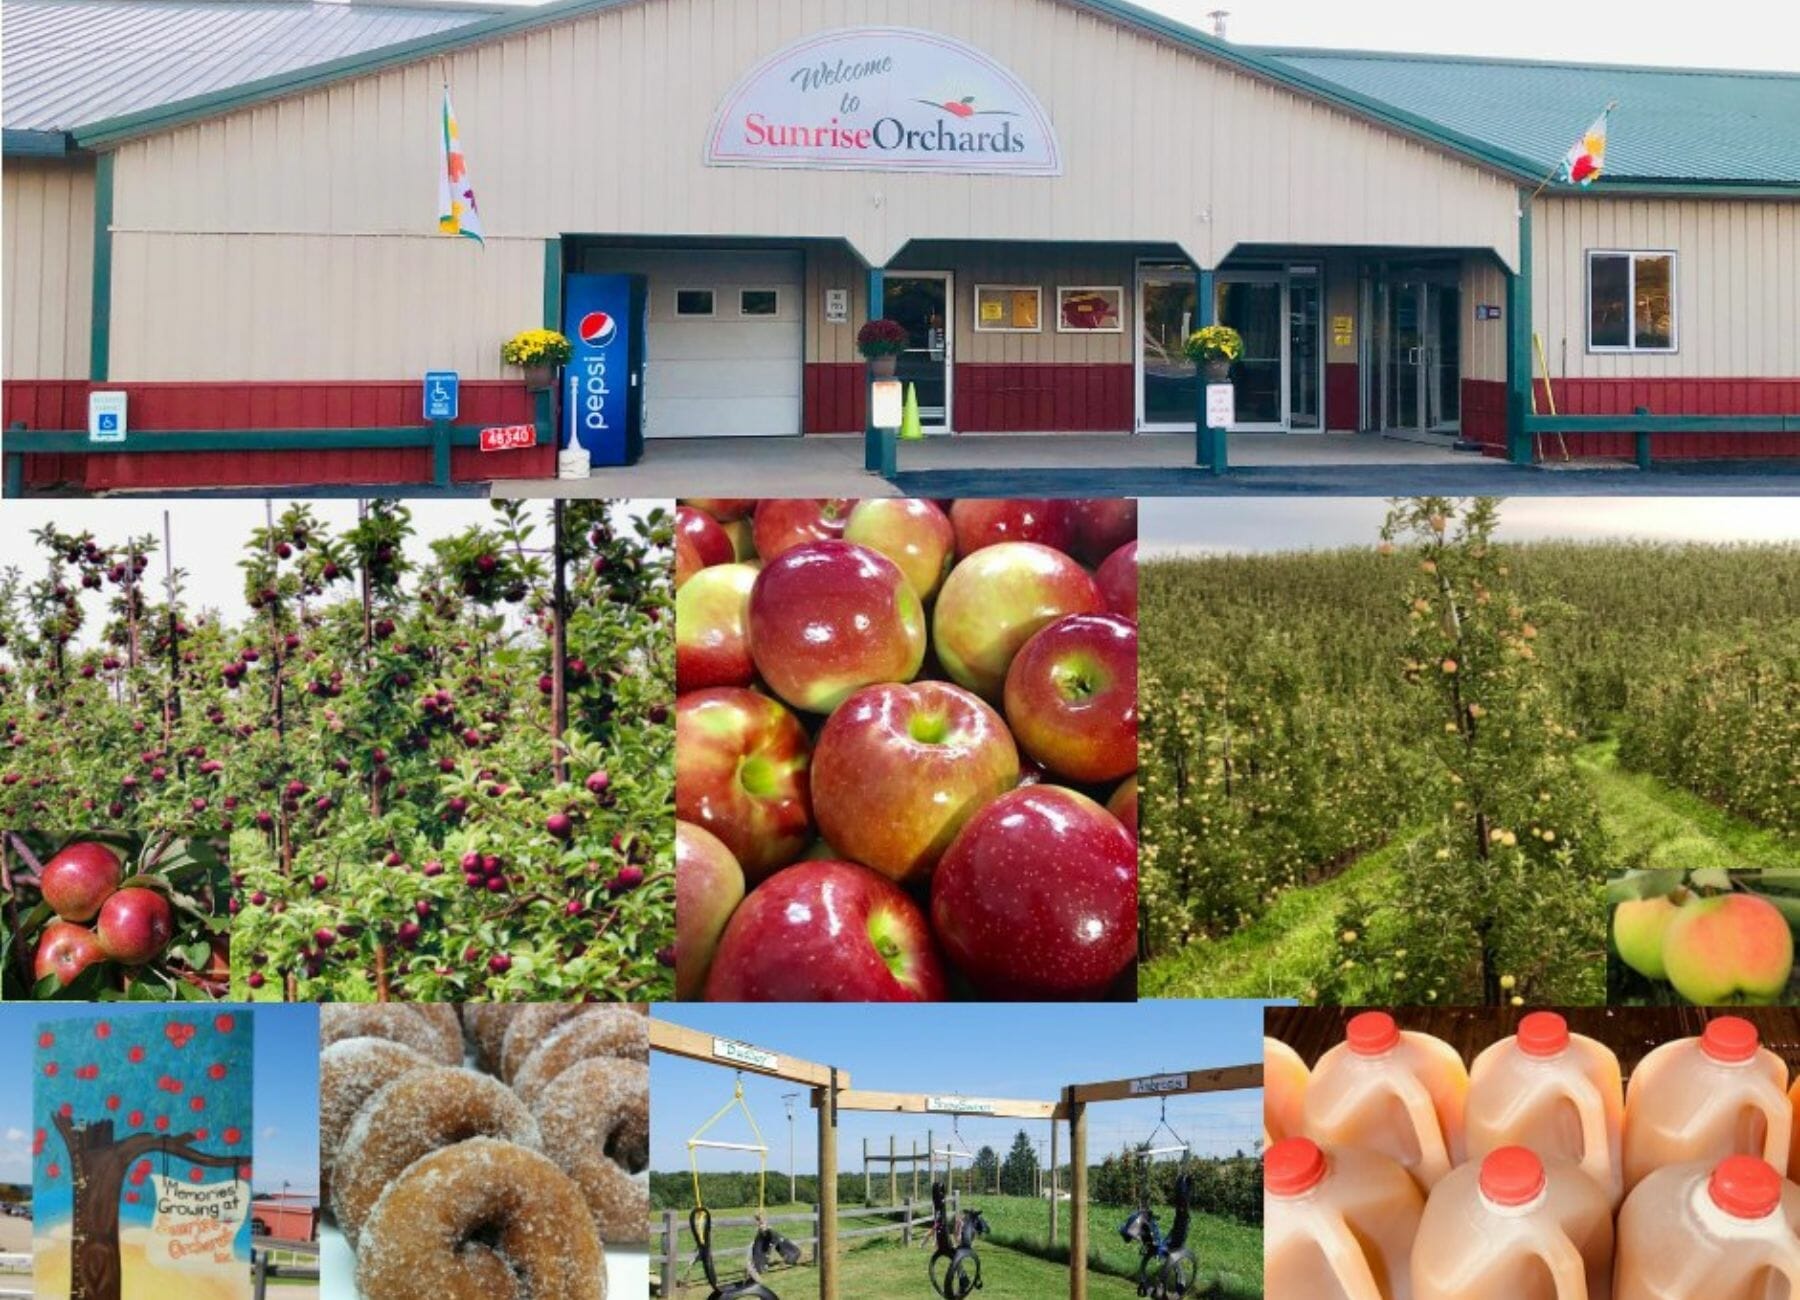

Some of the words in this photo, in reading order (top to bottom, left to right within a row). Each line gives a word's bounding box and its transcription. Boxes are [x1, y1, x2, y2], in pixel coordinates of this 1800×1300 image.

[790, 55, 893, 93] Welcome
[839, 92, 861, 114] to
[165, 1180, 236, 1202] Memories
[158, 1198, 219, 1218] Growing
[223, 1196, 239, 1210] at
